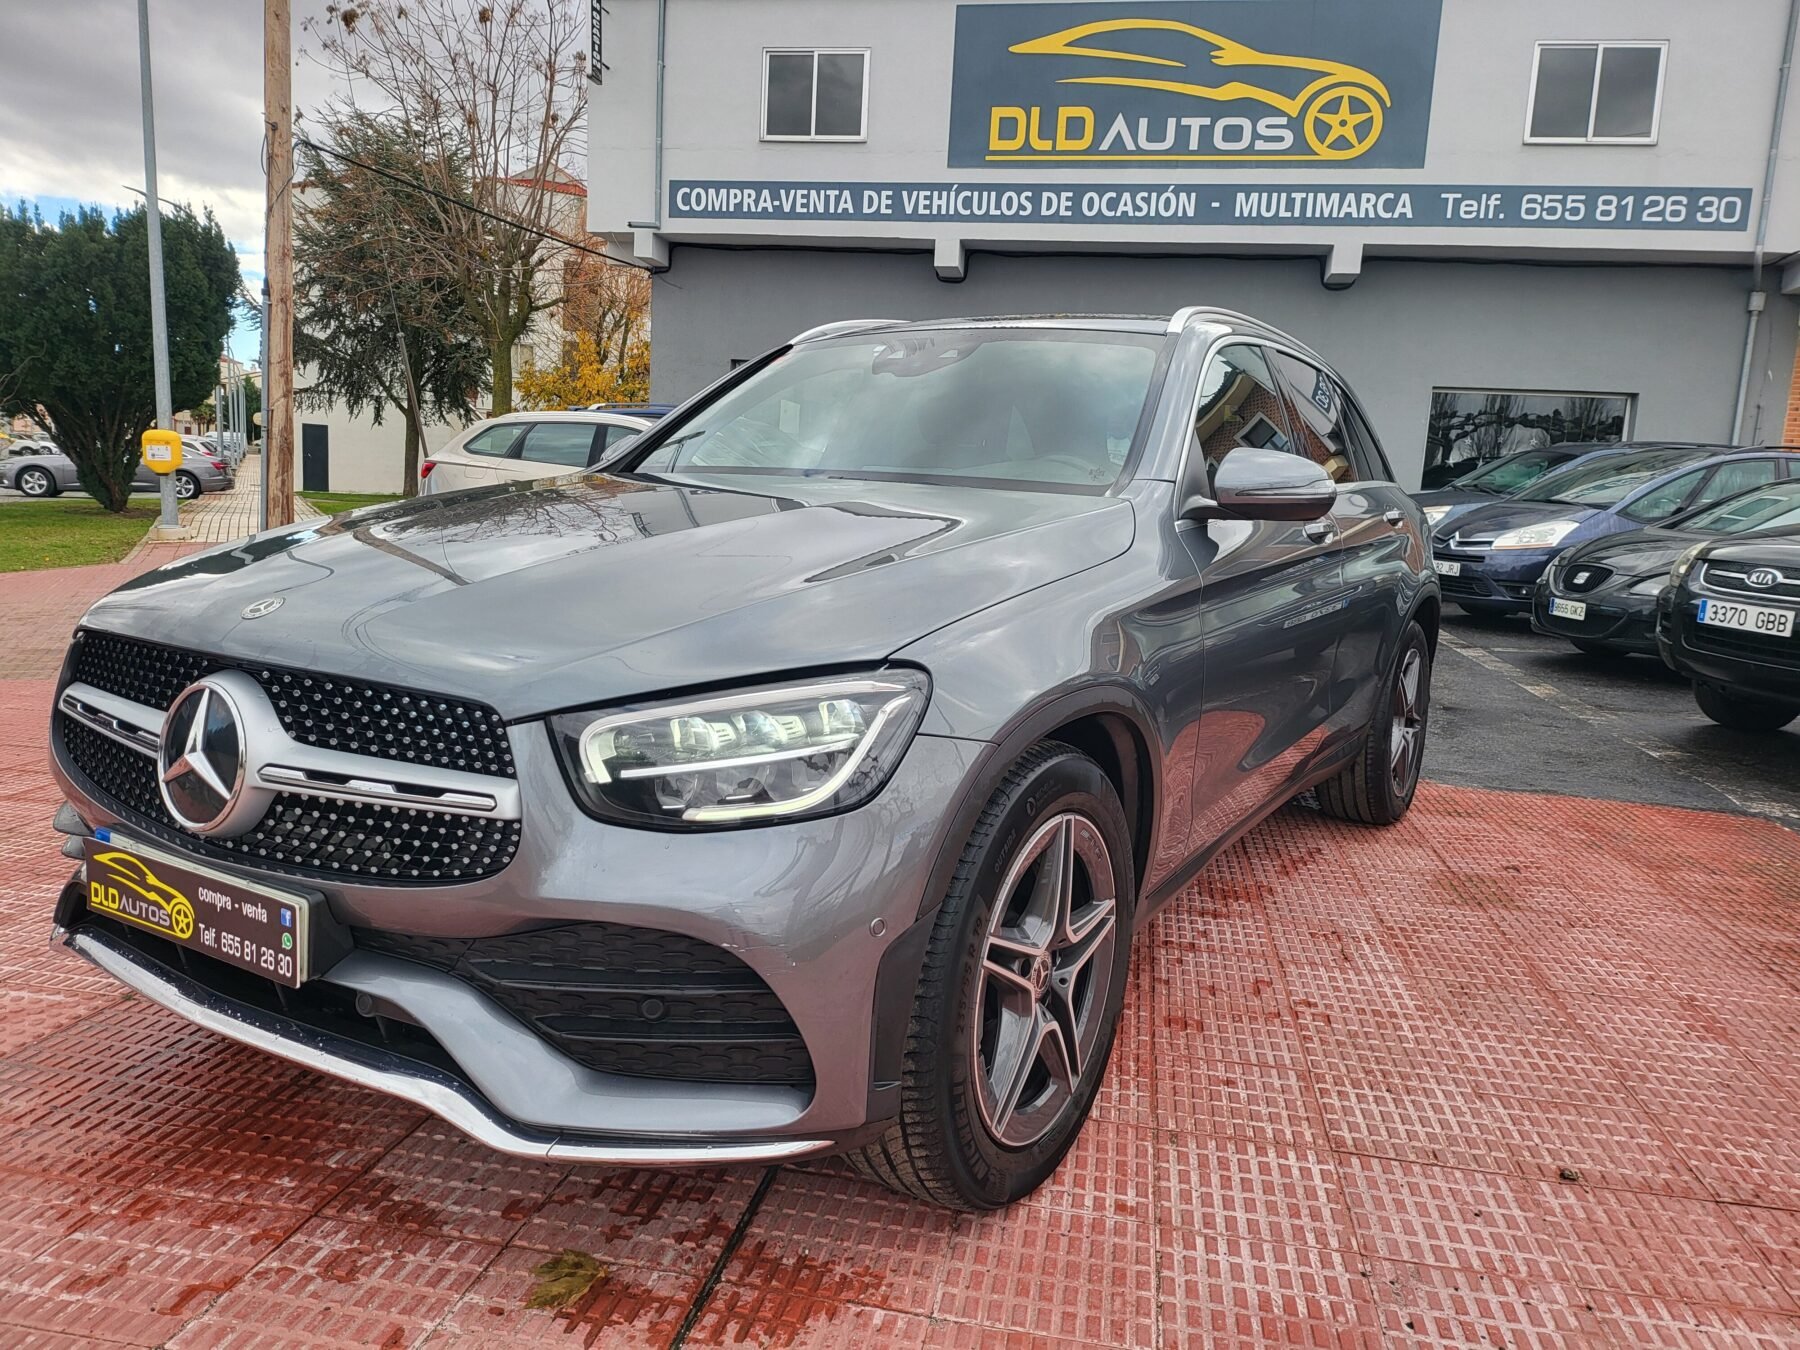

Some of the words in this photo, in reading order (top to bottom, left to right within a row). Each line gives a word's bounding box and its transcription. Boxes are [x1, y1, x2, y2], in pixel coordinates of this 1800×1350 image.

[676, 187, 854, 214] COMPRA-VENTA
[863, 190, 893, 214] DE
[902, 184, 1032, 216] VEHÍCULOS
[1040, 192, 1073, 216] DE
[1082, 186, 1196, 217] OCASIÓN
[1234, 192, 1413, 219] MULTIMARCA
[1441, 193, 1504, 219] Telf.
[1520, 194, 1586, 221] 655
[1696, 196, 1742, 224] 30
[1749, 573, 1773, 585] KIA
[1709, 604, 1748, 626] 3370
[1755, 611, 1788, 633] GBB
[198, 886, 231, 911] compra
[242, 899, 267, 923] venta
[199, 923, 217, 948] Telf.
[221, 931, 241, 957] 655
[244, 940, 257, 964] 81
[261, 947, 275, 969] 26
[278, 952, 292, 978] 30
